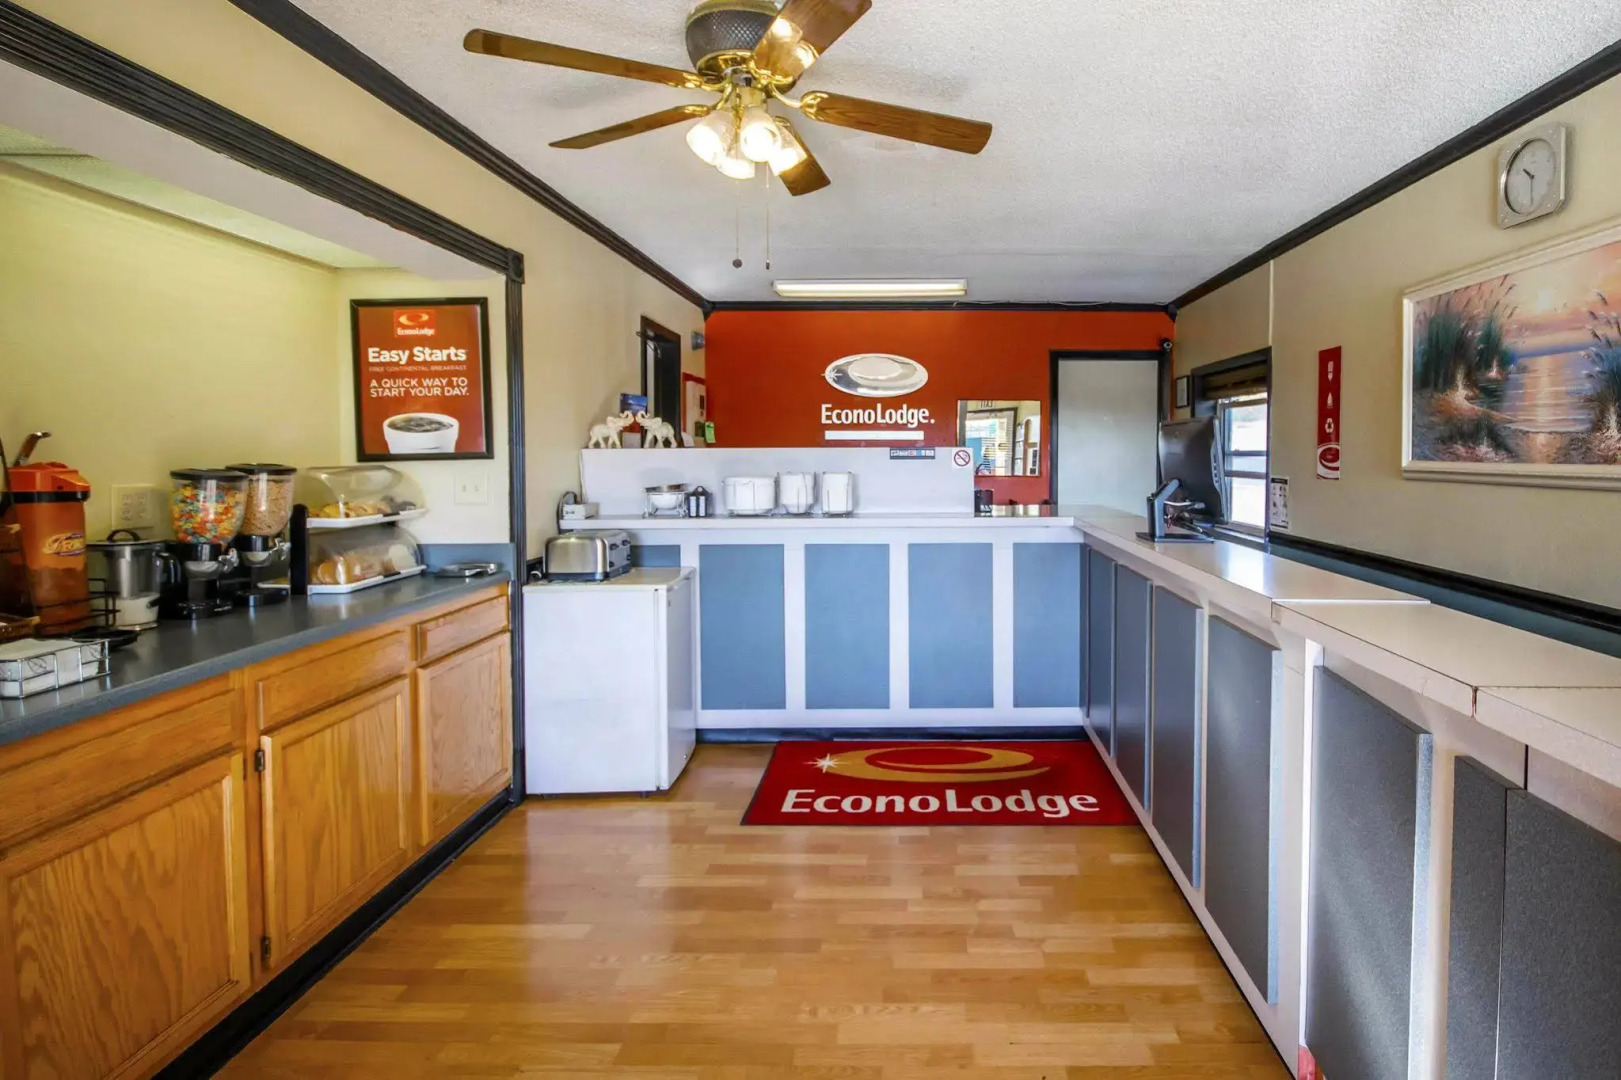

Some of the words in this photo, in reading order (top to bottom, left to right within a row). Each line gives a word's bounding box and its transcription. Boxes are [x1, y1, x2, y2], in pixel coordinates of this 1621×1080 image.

[368, 347, 409, 365] Easy
[412, 346, 467, 362] Starts
[370, 379, 378, 388] A
[381, 378, 418, 388] QUICK
[421, 377, 448, 387] WAY
[451, 376, 468, 387] TO
[370, 387, 405, 398] START
[409, 387, 441, 397] YOUR
[444, 386, 469, 396] DAY.
[781, 788, 1100, 818] EconoLodge
